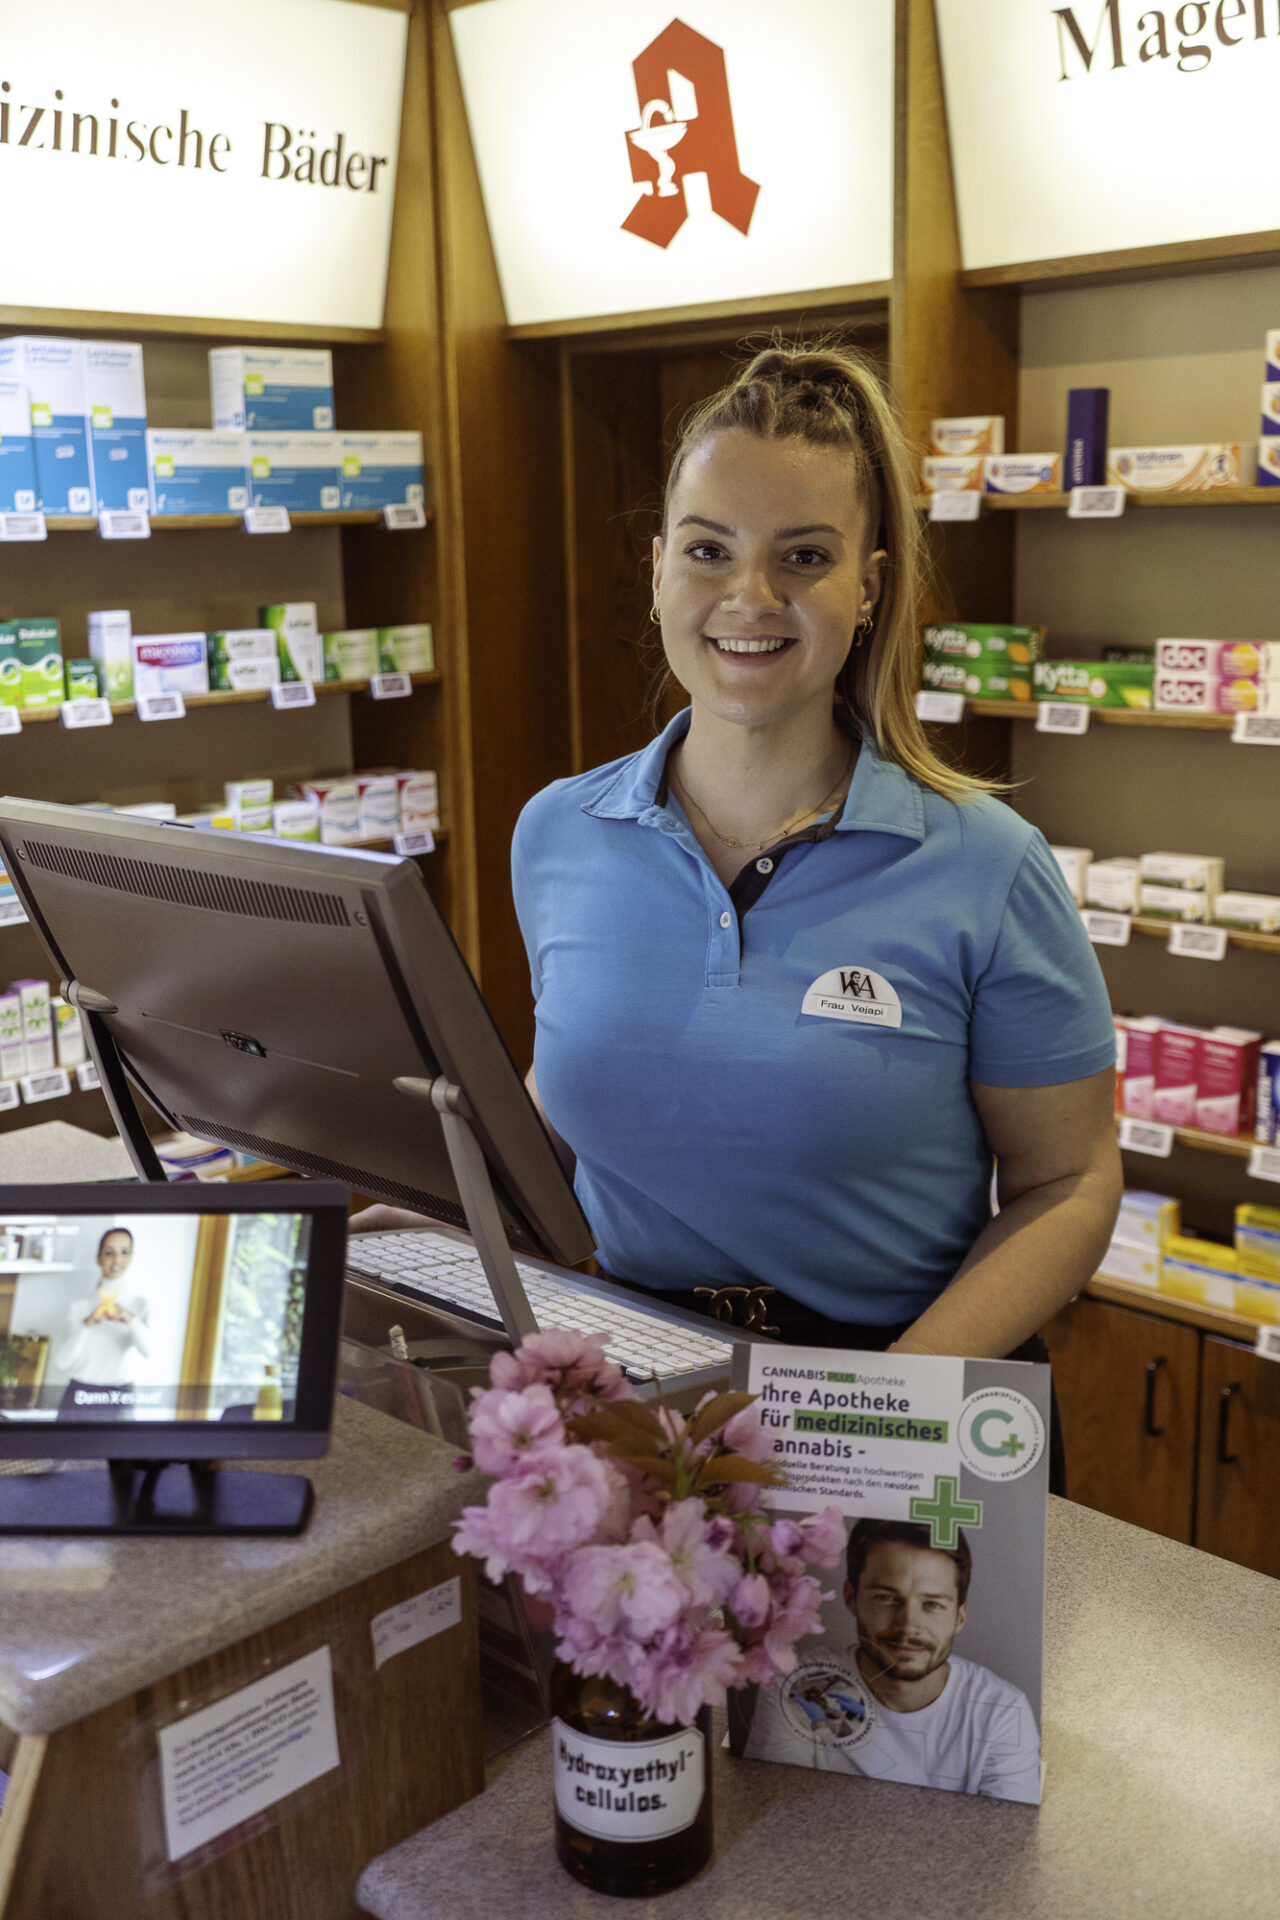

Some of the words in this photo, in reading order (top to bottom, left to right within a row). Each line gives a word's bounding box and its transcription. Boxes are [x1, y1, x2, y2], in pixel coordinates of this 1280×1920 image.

[260, 122, 389, 194] Bäder
[1033, 662, 1090, 693] Kytta
[820, 999, 845, 1011] Frau
[762, 1366, 826, 1381] CANNABIS
[828, 1372, 856, 1384] PLUS
[857, 1374, 906, 1388] Apotheke
[807, 1388, 911, 1412] Apotheke
[760, 1408, 791, 1429] für
[796, 1414, 943, 1442] medizinisches
[772, 1438, 853, 1459] annabis
[810, 1462, 850, 1475] Beratung
[853, 1467, 862, 1475] zu
[864, 1466, 924, 1480] hochwertigen
[819, 1487, 866, 1499] Standards.
[844, 1476, 864, 1487] nach
[865, 1478, 882, 1489] den
[884, 1481, 921, 1492] neusten
